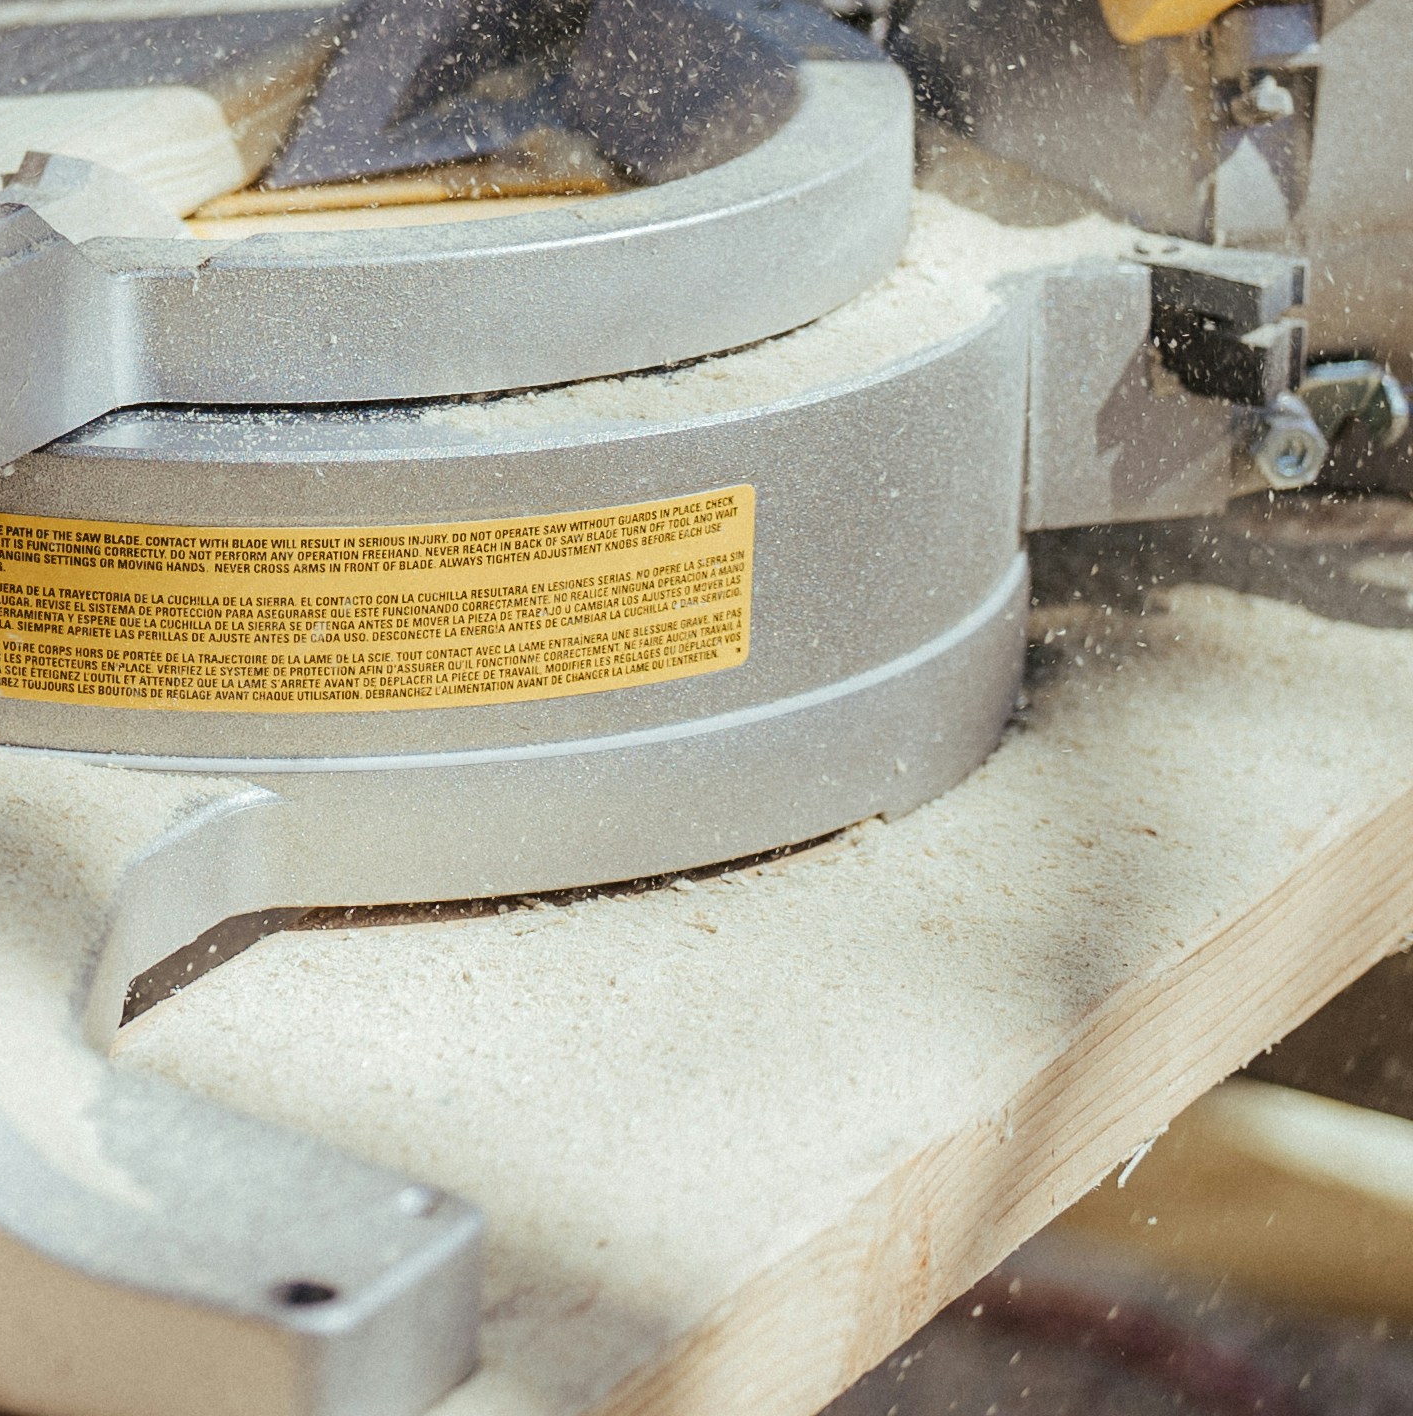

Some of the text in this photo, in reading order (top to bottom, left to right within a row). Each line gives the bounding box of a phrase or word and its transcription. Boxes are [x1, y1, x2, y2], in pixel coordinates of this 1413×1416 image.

[0, 537, 11, 548] IT
[11, 538, 24, 550] IS
[25, 540, 101, 555] FUNCTIONING
[103, 545, 168, 558] CORRECTLY.
[169, 548, 185, 559] DO
[188, 549, 212, 560] NOT
[214, 549, 267, 560] PERFORM
[270, 550, 293, 560] ANY
[297, 549, 358, 560] OPERATION
[425, 545, 459, 557] NEVER
[462, 542, 497, 554] REACH
[500, 540, 511, 551] IN
[514, 537, 542, 550] BACK
[545, 536, 557, 547] OF
[560, 533, 583, 545] SAW
[621, 524, 646, 537] TURN
[649, 520, 665, 533] OFF
[715, 506, 737, 521] WAIT
[5, 526, 33, 538] PATH
[35, 528, 51, 540] OF
[51, 530, 73, 541] THE
[75, 531, 101, 543] SAW
[145, 535, 196, 547] CONTACT
[199, 537, 229, 548] WITH
[231, 538, 268, 548] BLADE
[270, 538, 297, 548] WILL
[300, 537, 340, 548] RESULT
[343, 537, 355, 547] IN
[358, 535, 405, 547] SERIOUS
[408, 533, 449, 545] INJURY.
[451, 532, 466, 543] DO
[469, 530, 492, 542] NOT
[494, 526, 540, 540] OPERATE
[543, 523, 567, 535] SAW
[569, 517, 614, 532] WITHOUT
[618, 510, 657, 526] GUARDS
[659, 508, 670, 519] IN
[705, 495, 733, 511] CHECK
[43, 553, 96, 567] SETTINGS
[99, 557, 114, 568] OR
[117, 558, 163, 571] MOVING
[214, 562, 250, 573] NEVER
[253, 563, 289, 573] CROSS
[293, 562, 325, 573] ARMS
[329, 562, 340, 572] IN
[344, 561, 379, 572] FRONT
[382, 560, 396, 571] OF
[439, 555, 483, 568] ALWAYS
[486, 551, 530, 565] TIGHTEN
[533, 542, 601, 560] ADJUSTMENT
[604, 537, 638, 552] KNOBS
[641, 531, 675, 546] BEFORE
[678, 526, 702, 540] EACH
[35, 598, 71, 611] REVISE
[73, 601, 86, 612] EL
[88, 602, 136, 615] SISTEMA
[136, 605, 152, 616] DE
[225, 608, 253, 619] PARA
[256, 608, 327, 619] ASEGURARSE
[330, 607, 351, 618] QUE
[382, 602, 459, 617] FUNCIONANDO
[611, 579, 654, 595] NINGUNA
[57, 588, 131, 603] TRAYECTORIA
[167, 594, 219, 606] CUCHILLA
[315, 595, 372, 606] CONTACTO
[376, 594, 398, 605] CON
[547, 576, 594, 592] LESIONES
[67, 613, 74, 623] Y
[77, 613, 117, 626] ESPERE
[158, 618, 211, 630] CUCHILLA
[357, 618, 392, 630] ANTES
[412, 615, 449, 627] MOVER
[468, 611, 496, 623] PIEZA
[621, 593, 638, 606] LOS
[642, 586, 681, 603] AJUSTES
[2, 640, 35, 653] VOTRE
[37, 644, 72, 656] CORPS
[75, 646, 103, 659] HORS
[197, 653, 268, 665] TRAJECTOIRE
[303, 654, 332, 664] LAME
[397, 650, 422, 661] TOUT
[426, 646, 472, 660] CONTACT
[475, 643, 501, 656] AVEC
[633, 620, 677, 637] BLESSURE
[15, 610, 606, 643] SIEMPRE APRIETE LAS PERILLAS AJUSTE ANTES USO. DESCONECTE CAMBIAR
[3, 652, 22, 664] LES
[24, 654, 98, 670] PROTECTEURS
[289, 665, 355, 676] PROTECTION
[4, 656, 591, 688] SCIE QUE AVANT MODIFIER
[21, 678, 74, 693] TOUJOURS
[77, 683, 95, 694] LES
[97, 684, 148, 698] BOUTONS
[214, 690, 248, 701] AVANT
[252, 691, 294, 701] CHAQUE
